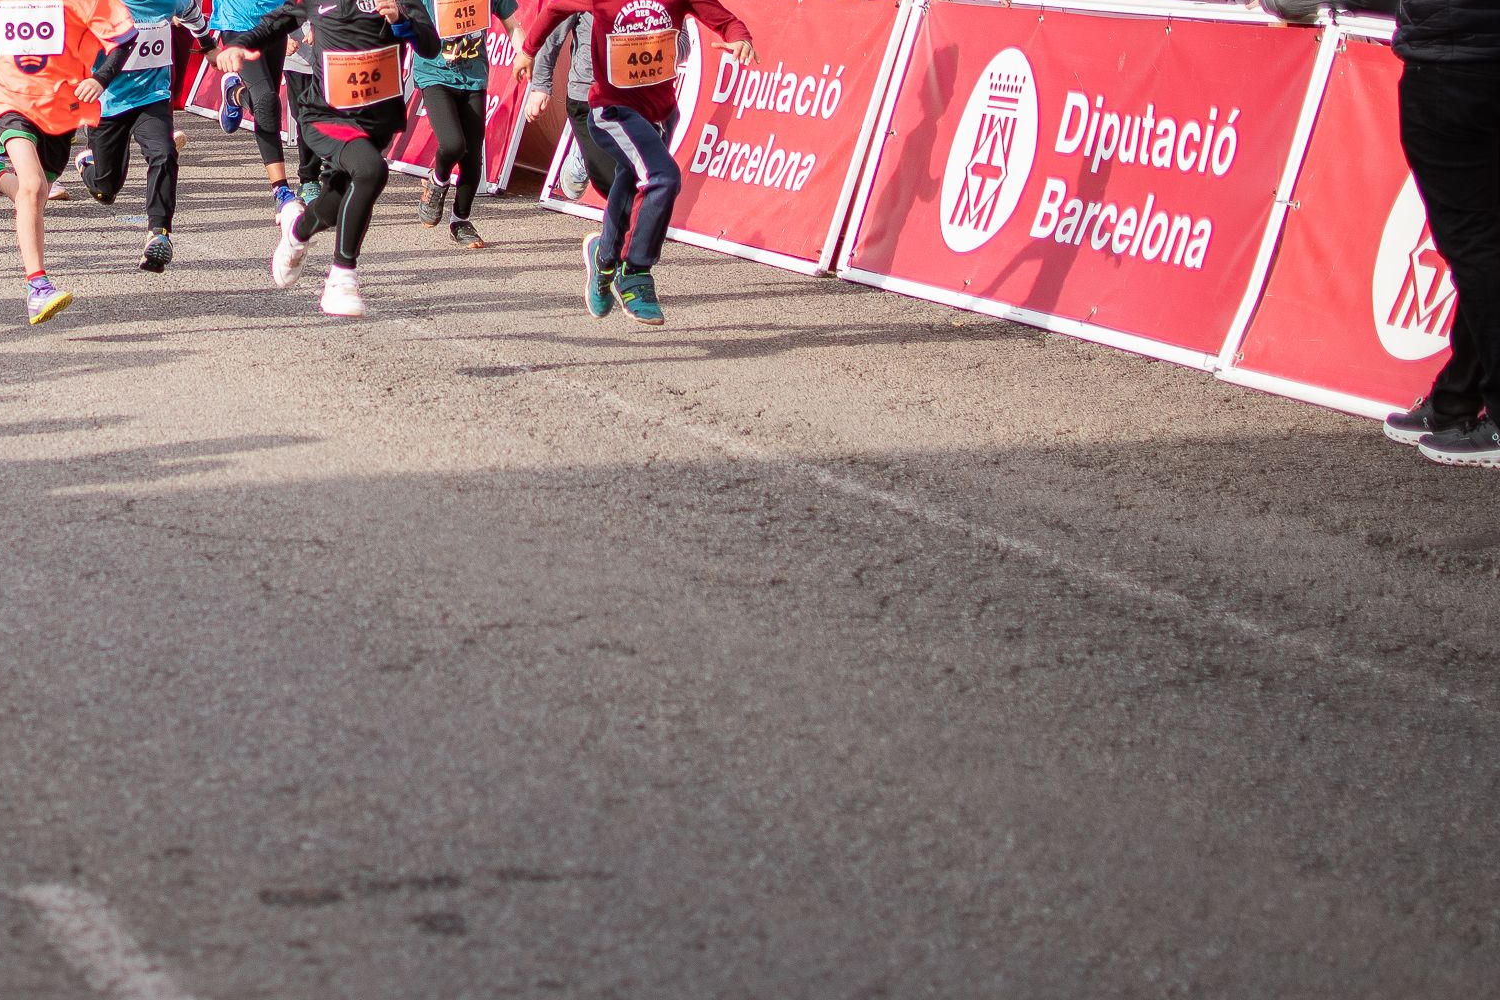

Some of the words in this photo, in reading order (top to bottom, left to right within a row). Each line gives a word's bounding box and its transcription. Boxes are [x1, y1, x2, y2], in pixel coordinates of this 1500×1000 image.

[454, 5, 476, 19] 415
[621, 0, 665, 16] ACADEMY
[4, 21, 55, 41] 800
[456, 19, 477, 30] BIEL
[134, 39, 165, 58] 60
[627, 49, 664, 67] 404
[346, 68, 382, 86] 426
[628, 67, 663, 80] MARC
[351, 86, 380, 99] BIEL
[712, 52, 845, 120] Diputació
[1054, 90, 1240, 177] Diputació
[690, 123, 817, 192] Barcelona
[1029, 176, 1213, 270] Barcelona
